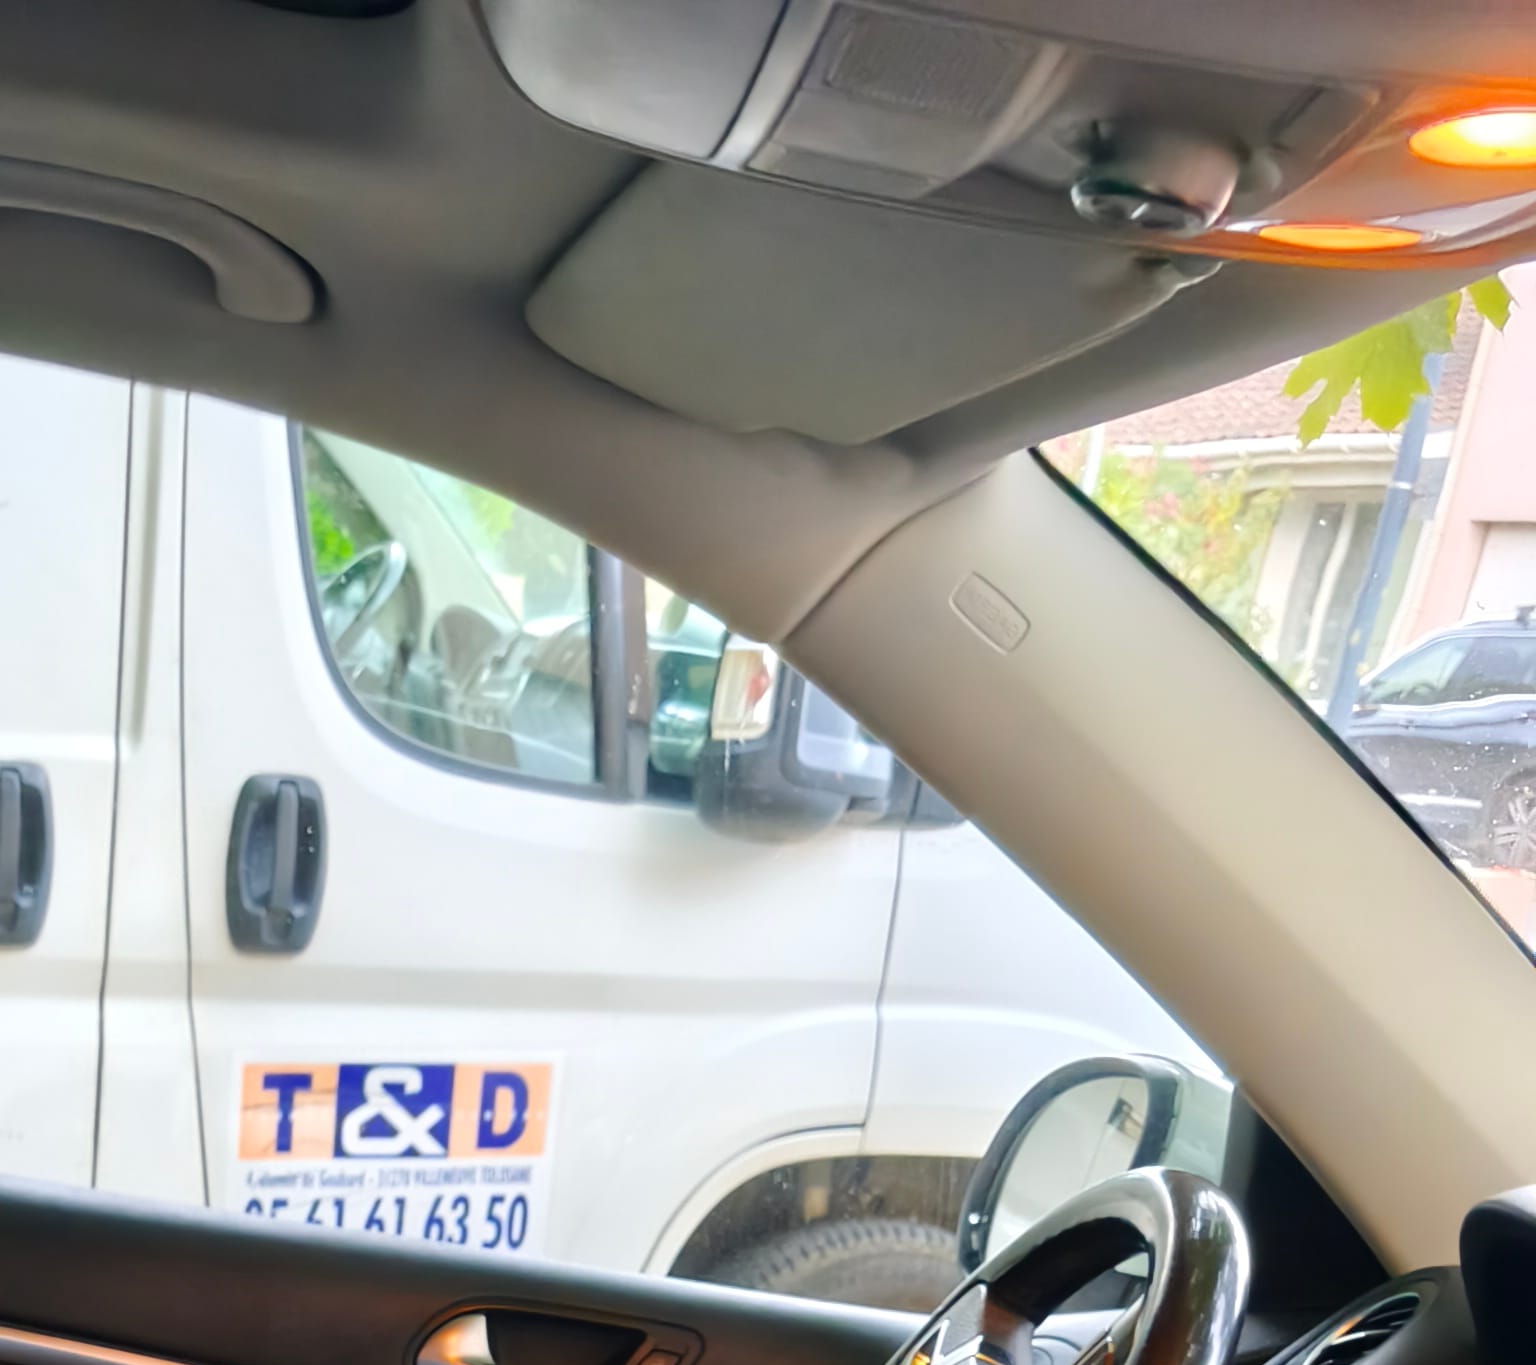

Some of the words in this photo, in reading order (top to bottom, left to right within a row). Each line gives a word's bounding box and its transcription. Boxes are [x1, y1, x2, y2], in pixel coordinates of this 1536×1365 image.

[262, 1073, 312, 1152] T
[341, 1065, 447, 1157] &
[476, 1071, 529, 1149] D
[424, 1195, 470, 1245] 63
[481, 1193, 529, 1250] 50
